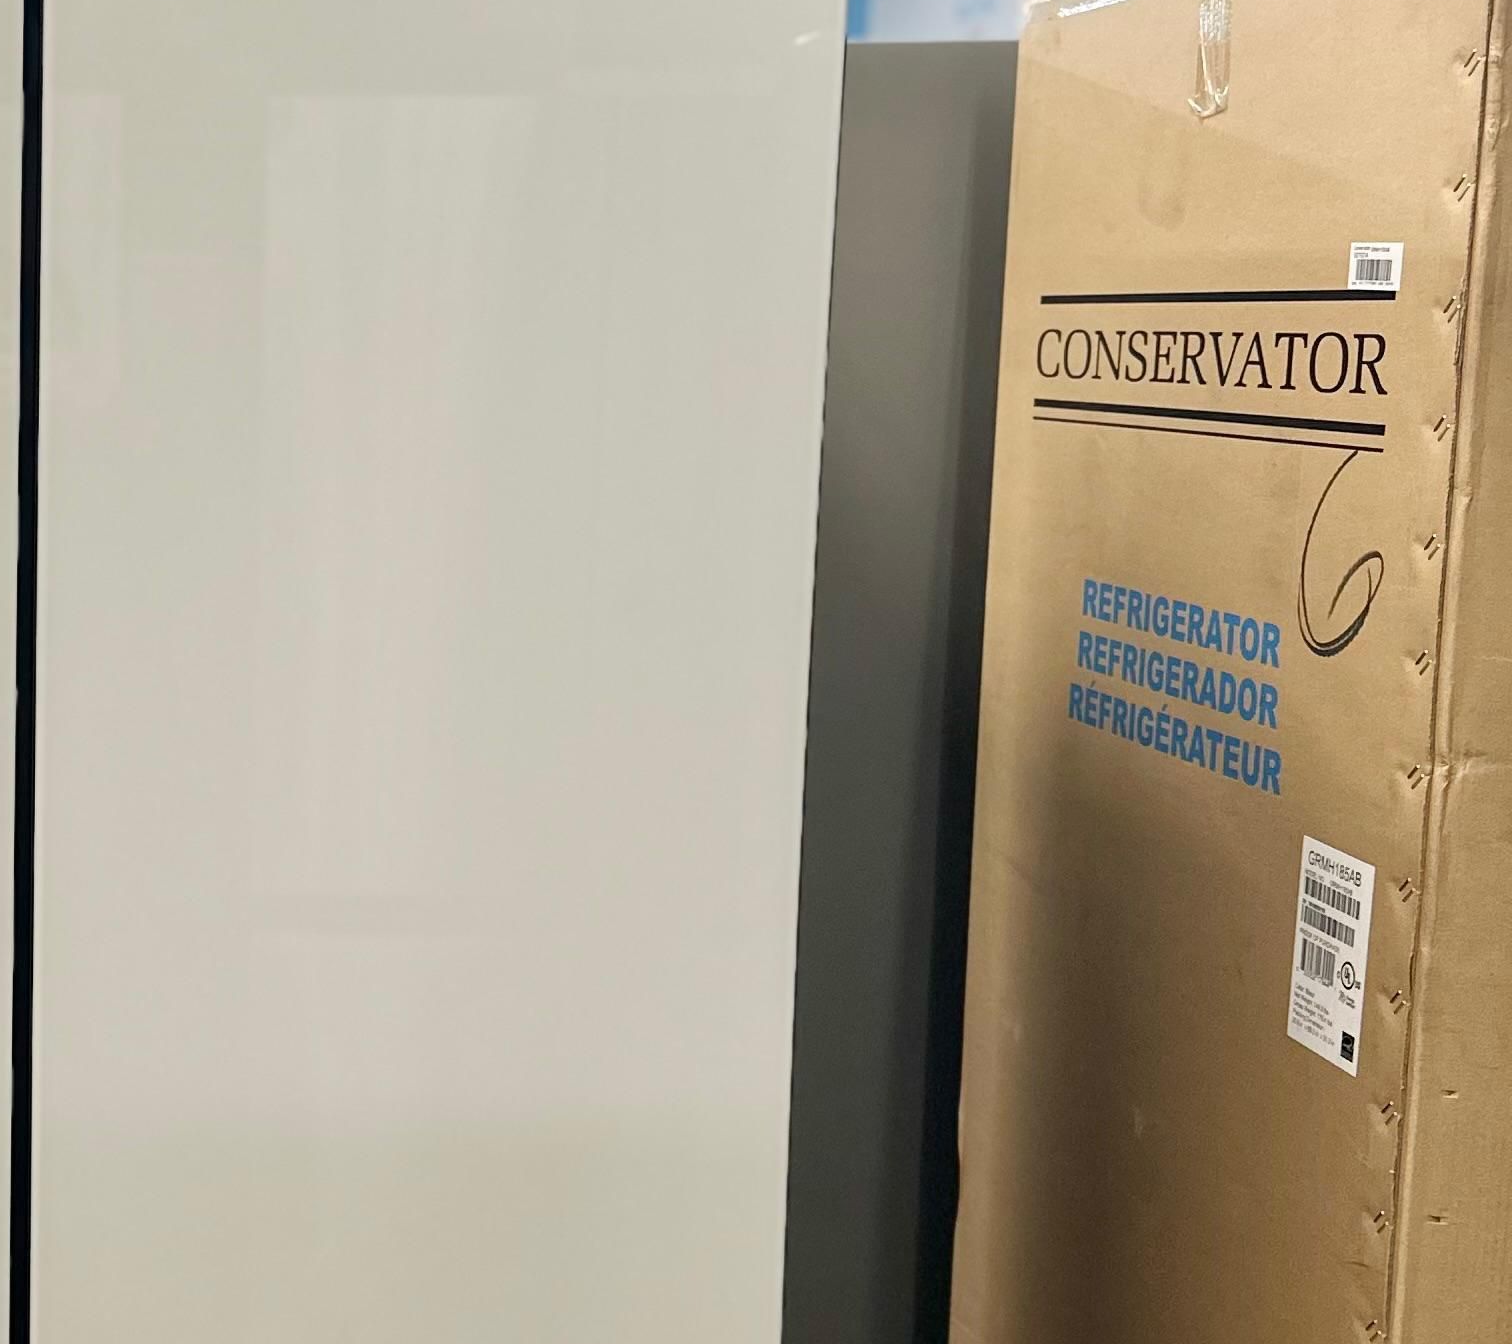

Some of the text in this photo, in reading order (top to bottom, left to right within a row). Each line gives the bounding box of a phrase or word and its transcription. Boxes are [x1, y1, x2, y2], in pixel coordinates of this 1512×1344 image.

[1036, 328, 1388, 395] CONSERVATOR
[1082, 578, 1281, 668] REFRIGERATOR
[1077, 630, 1279, 729] REFRIGERADOR
[1068, 680, 1283, 796] RÉFRIGÉRATEUR
